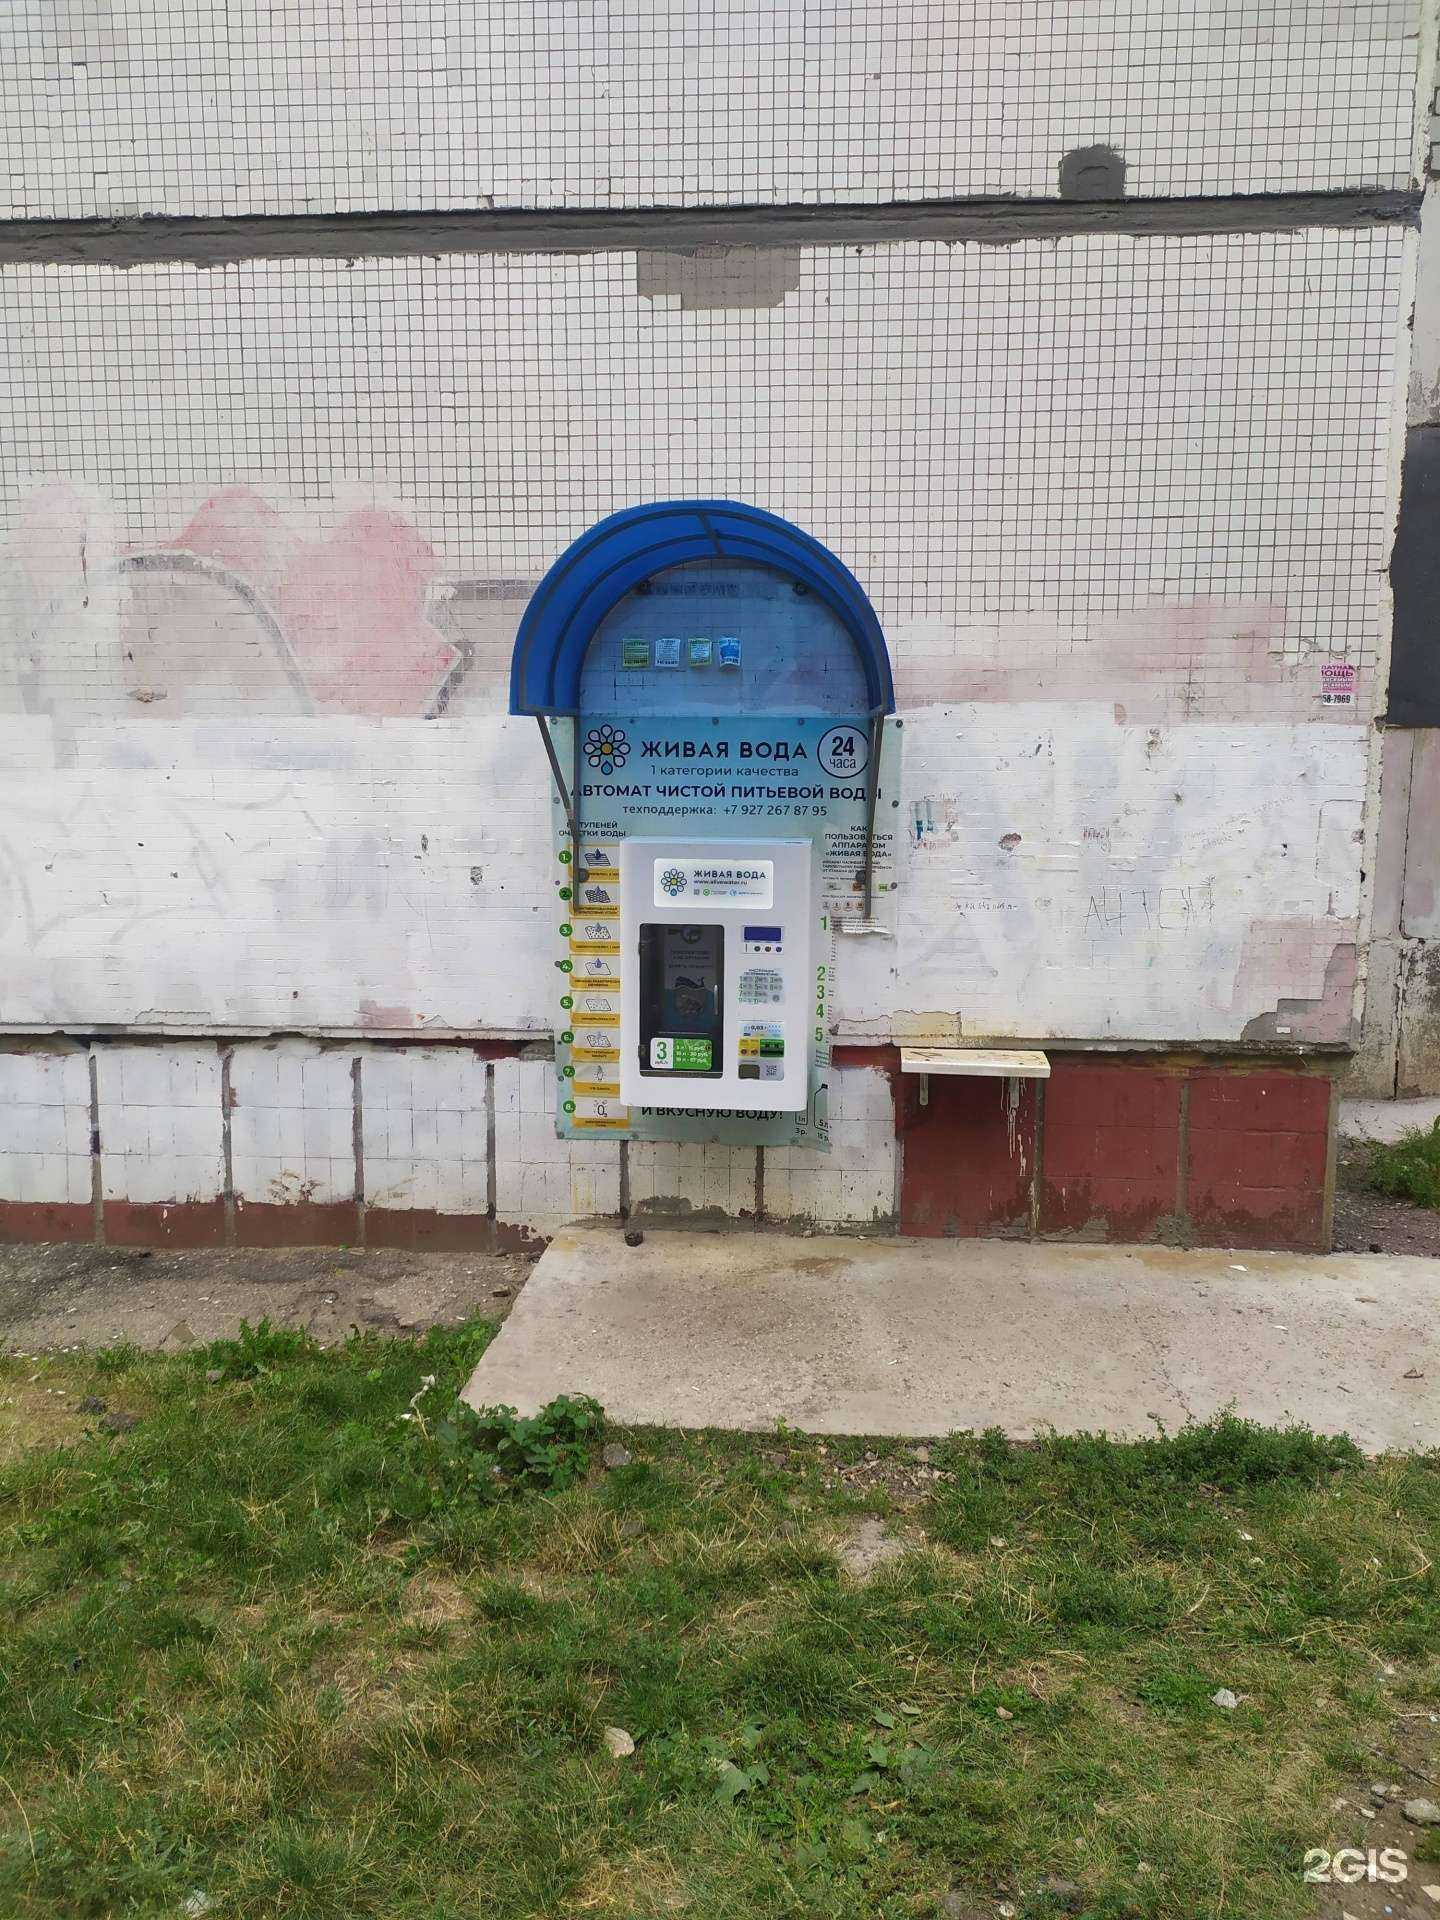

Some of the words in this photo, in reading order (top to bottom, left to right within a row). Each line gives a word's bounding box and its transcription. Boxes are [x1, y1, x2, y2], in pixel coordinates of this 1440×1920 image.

[641, 741, 729, 758] ЖИВАЯ
[739, 741, 808, 761] ВОДА
[831, 736, 855, 757] 24
[829, 758, 856, 769] часа
[651, 766, 656, 776] 1
[660, 767, 732, 777] категории
[736, 768, 799, 777] качества
[656, 783, 726, 797] ЧИСТОЙ
[731, 784, 824, 799] ПИТЬЕВОЙ
[622, 805, 717, 817] техподдержка:
[723, 805, 737, 816] +7
[741, 805, 763, 816] 927
[767, 805, 788, 816] 267
[793, 805, 808, 816] 87
[812, 806, 827, 816] 95
[600, 830, 626, 838] ВОДЫ
[824, 833, 893, 841] ПОЛЬЗОВТЬСЯ
[831, 841, 886, 849] АППАРАОМ
[693, 870, 732, 878] ЖИВАЯ
[736, 871, 766, 880] ВОДА
[820, 916, 827, 931] 1
[816, 966, 826, 981] 2
[816, 985, 825, 1000] 3
[816, 1003, 824, 1018] 4
[815, 1027, 823, 1042] 5
[656, 1041, 667, 1060] 3
[641, 1106, 652, 1116] И
[656, 1107, 731, 1118] ВКУСНУЮ
